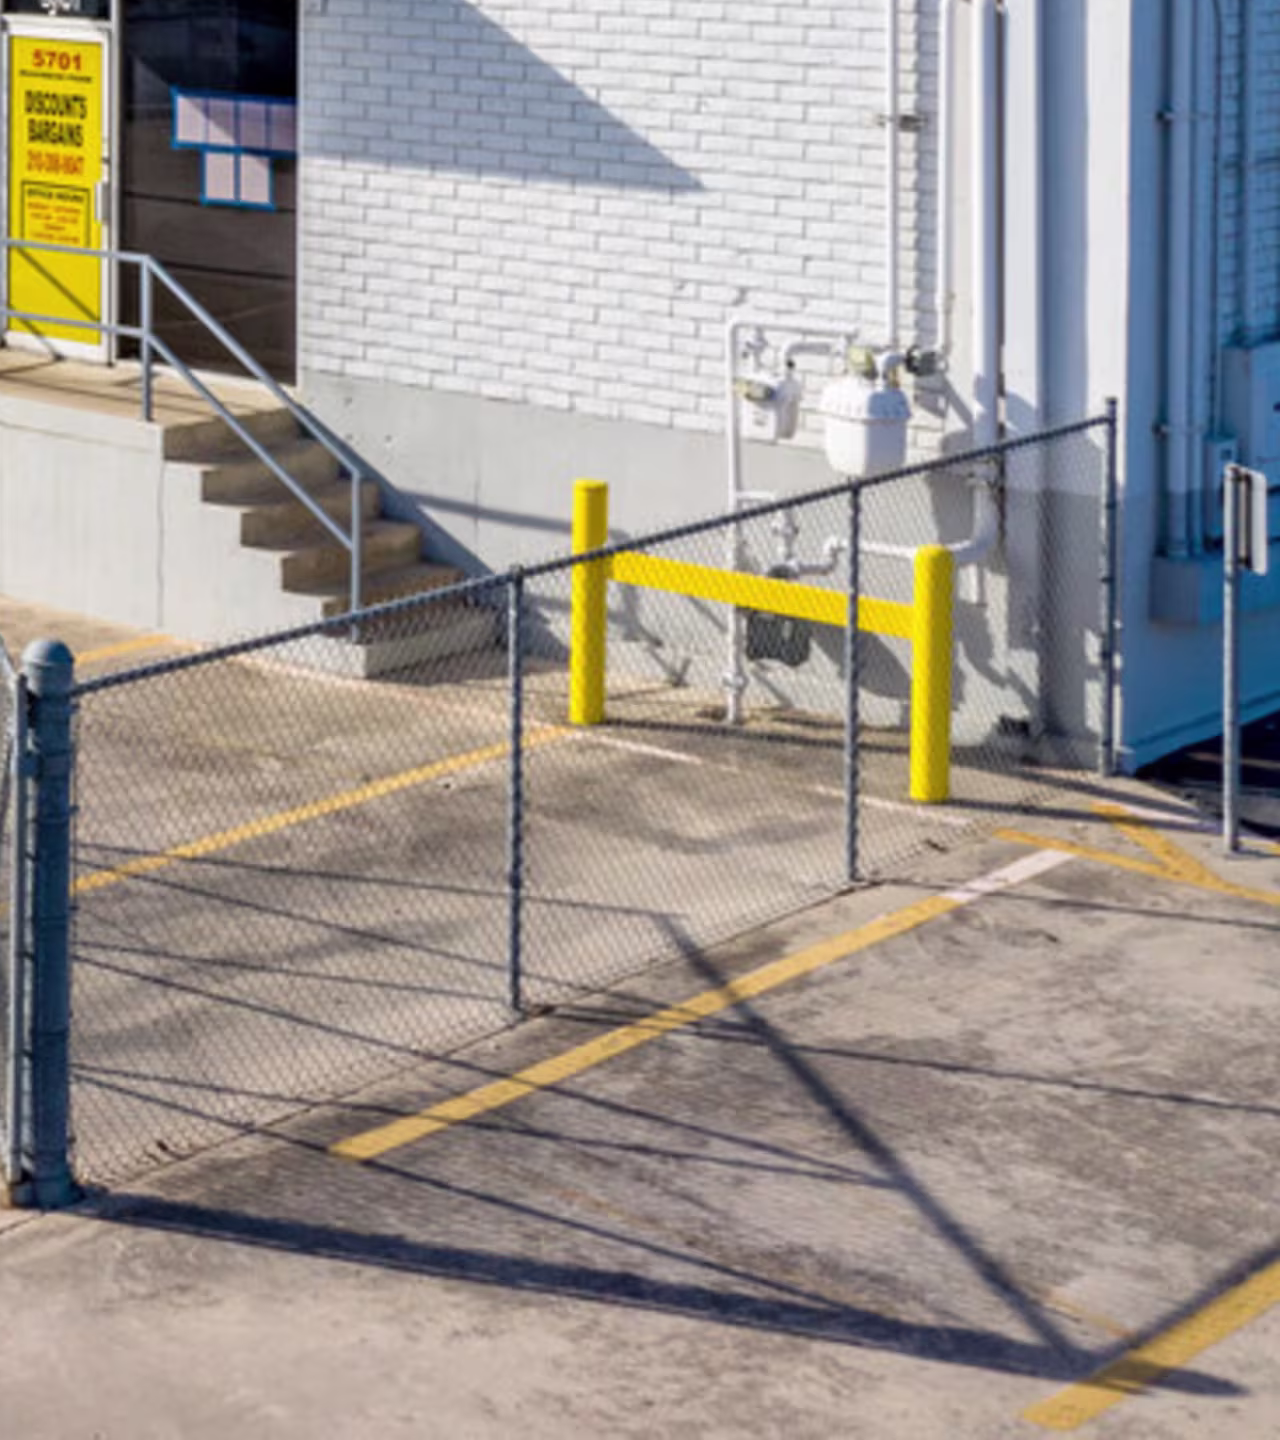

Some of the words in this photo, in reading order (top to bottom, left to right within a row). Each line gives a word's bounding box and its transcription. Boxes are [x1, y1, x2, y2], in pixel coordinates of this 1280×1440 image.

[32, 47, 83, 72] 5701
[24, 89, 88, 120] DISCOUNTS
[27, 117, 85, 148] BARGAINS
